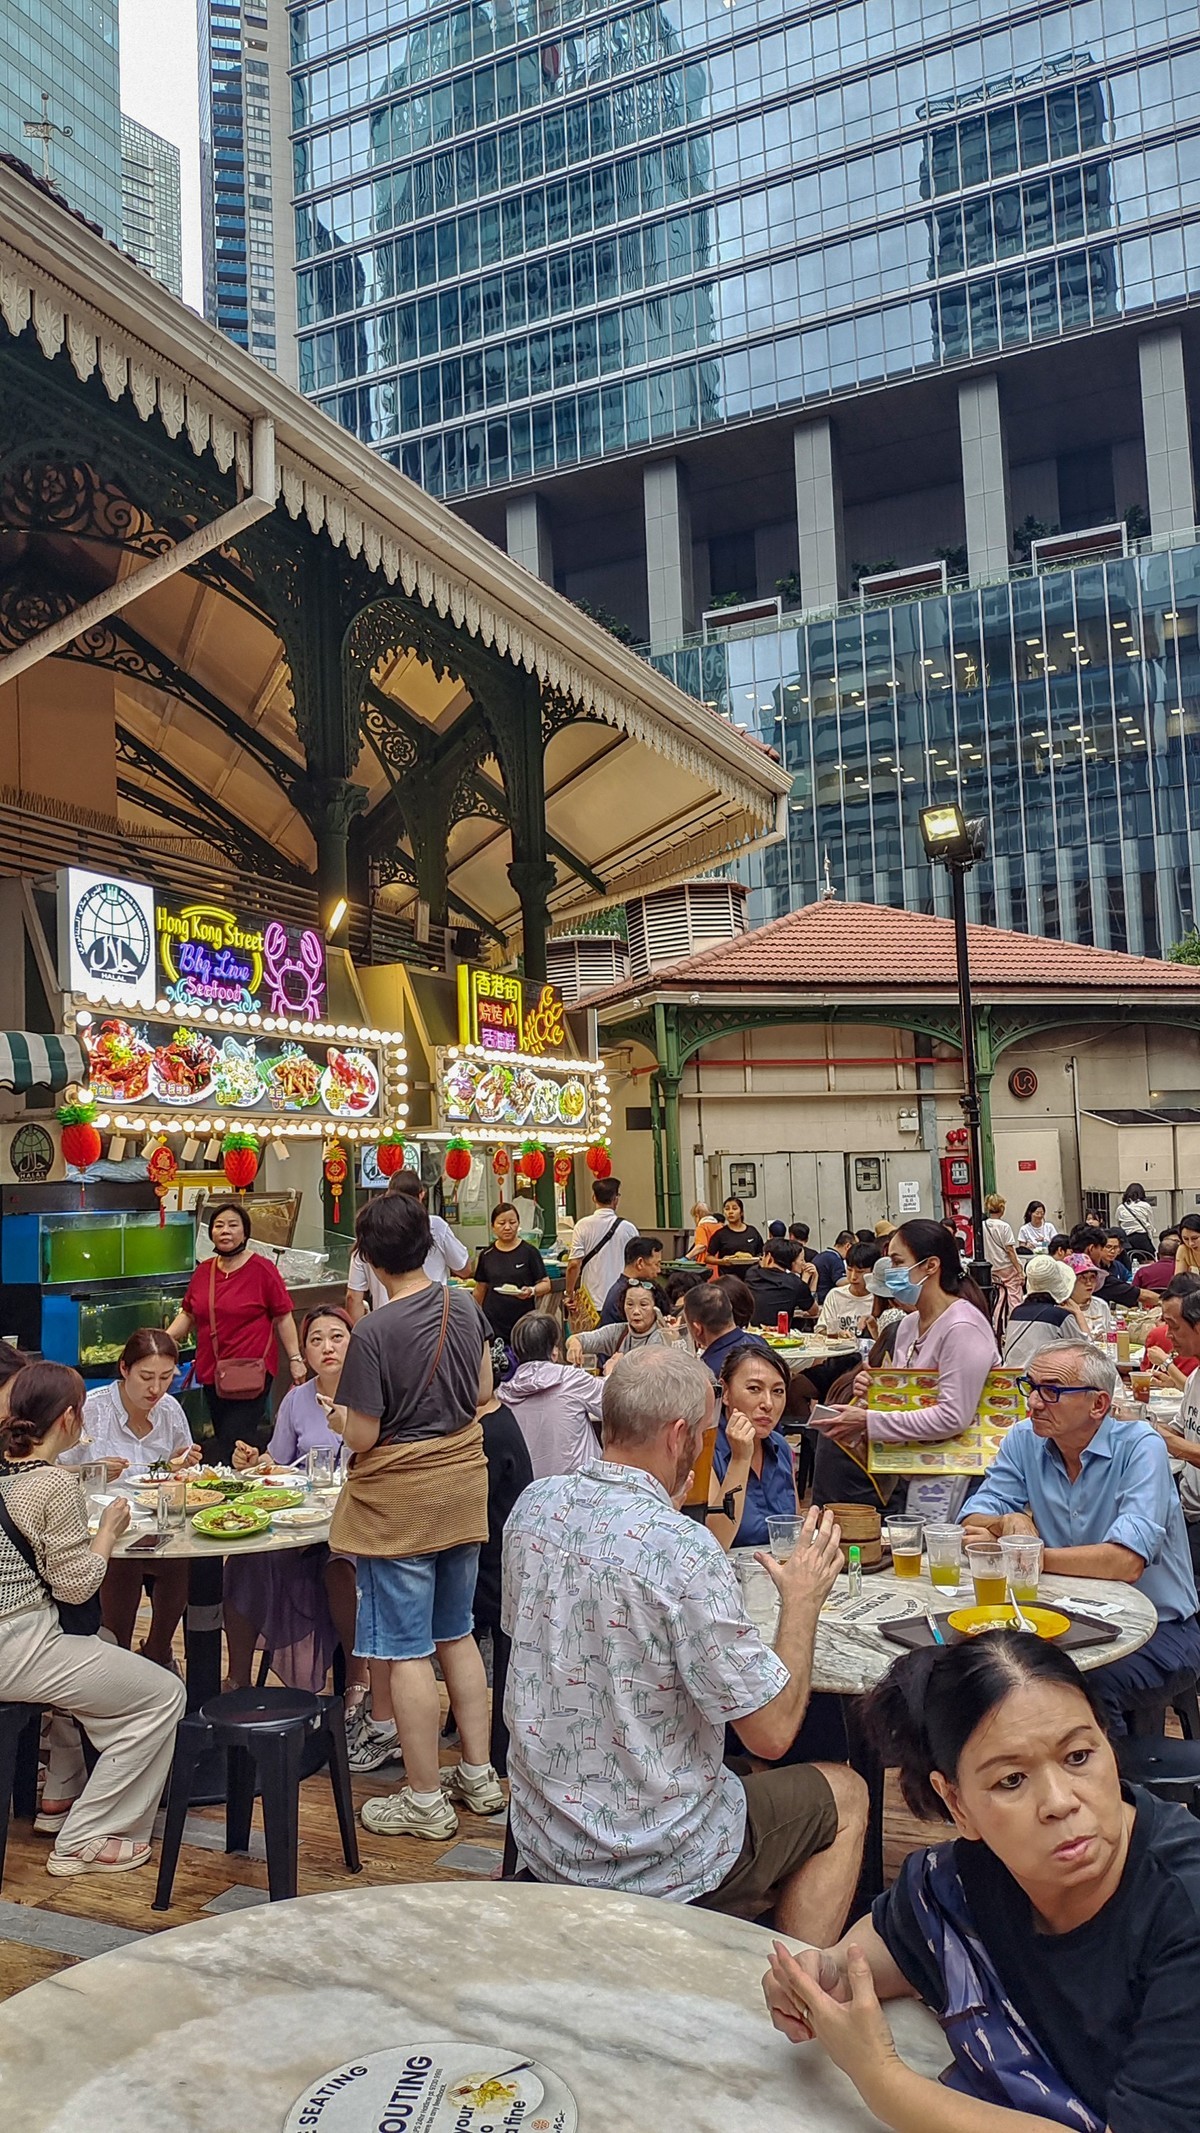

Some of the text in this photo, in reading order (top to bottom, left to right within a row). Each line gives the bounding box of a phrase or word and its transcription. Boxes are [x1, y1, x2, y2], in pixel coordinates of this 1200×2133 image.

[156, 907, 265, 951] Hong Kong Street
[101, 972, 127, 982] HALAL
[214, 951, 249, 981] Live
[186, 976, 242, 1002] Seafood
[476, 970, 518, 1002] 香港街
[842, 1600, 885, 1621] TOUTING
[876, 1608, 916, 1621] SEATING
[298, 2065, 368, 2125] SEATING
[503, 2100, 527, 2125] fine
